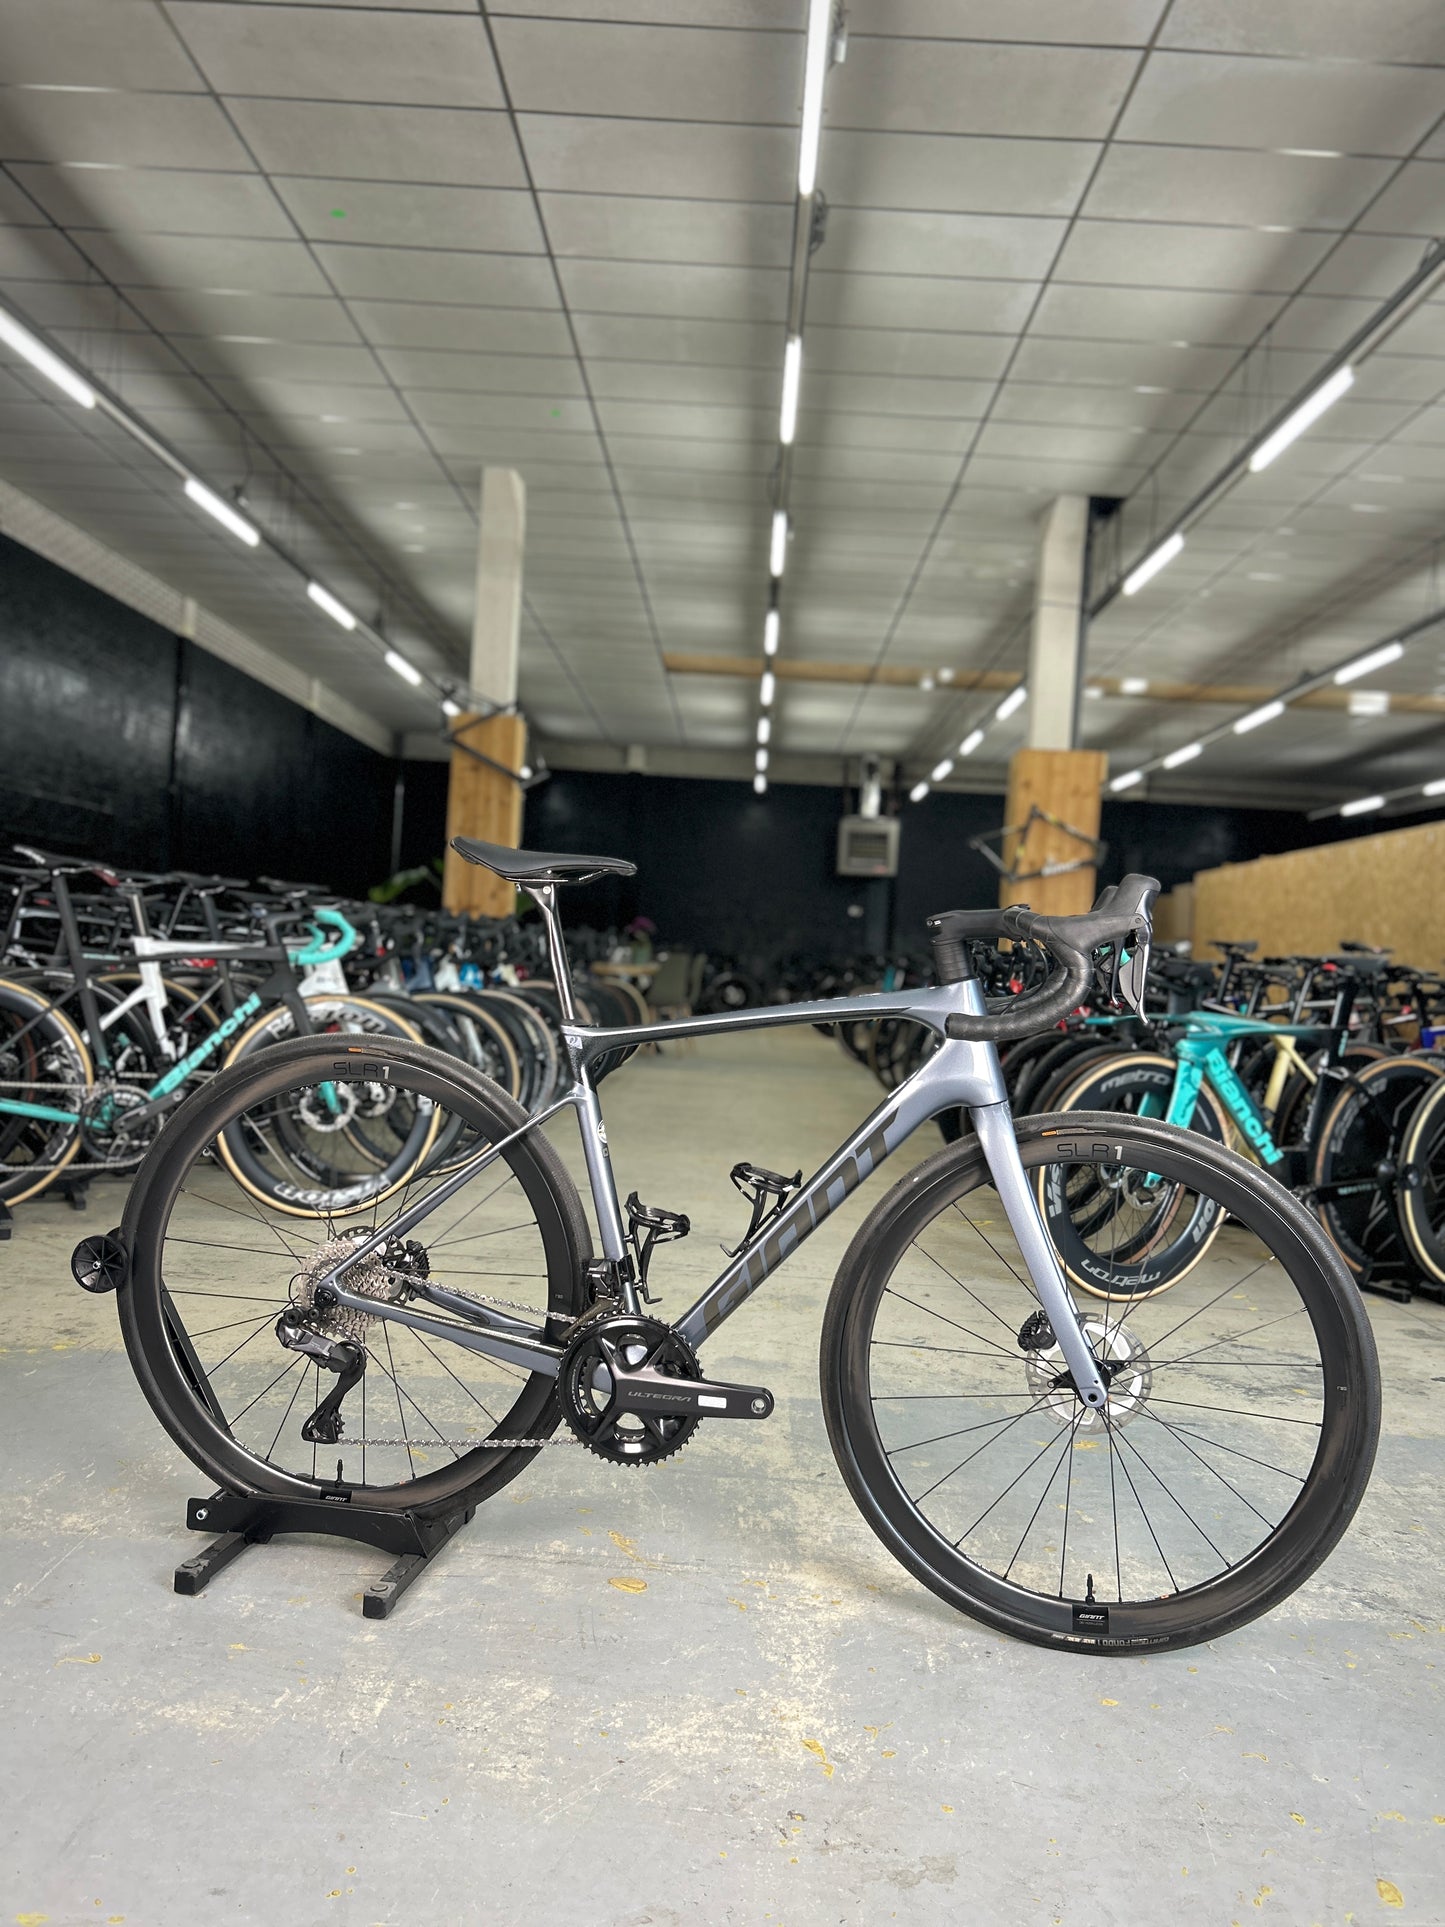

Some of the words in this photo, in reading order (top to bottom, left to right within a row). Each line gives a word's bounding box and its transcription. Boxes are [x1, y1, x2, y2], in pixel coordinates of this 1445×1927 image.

[1206, 1048, 1284, 1165] Bianchi
[702, 1106, 900, 1334] GIANT
[1081, 1259, 1161, 1287] metron
[627, 1390, 692, 1403] ULTEGRA
